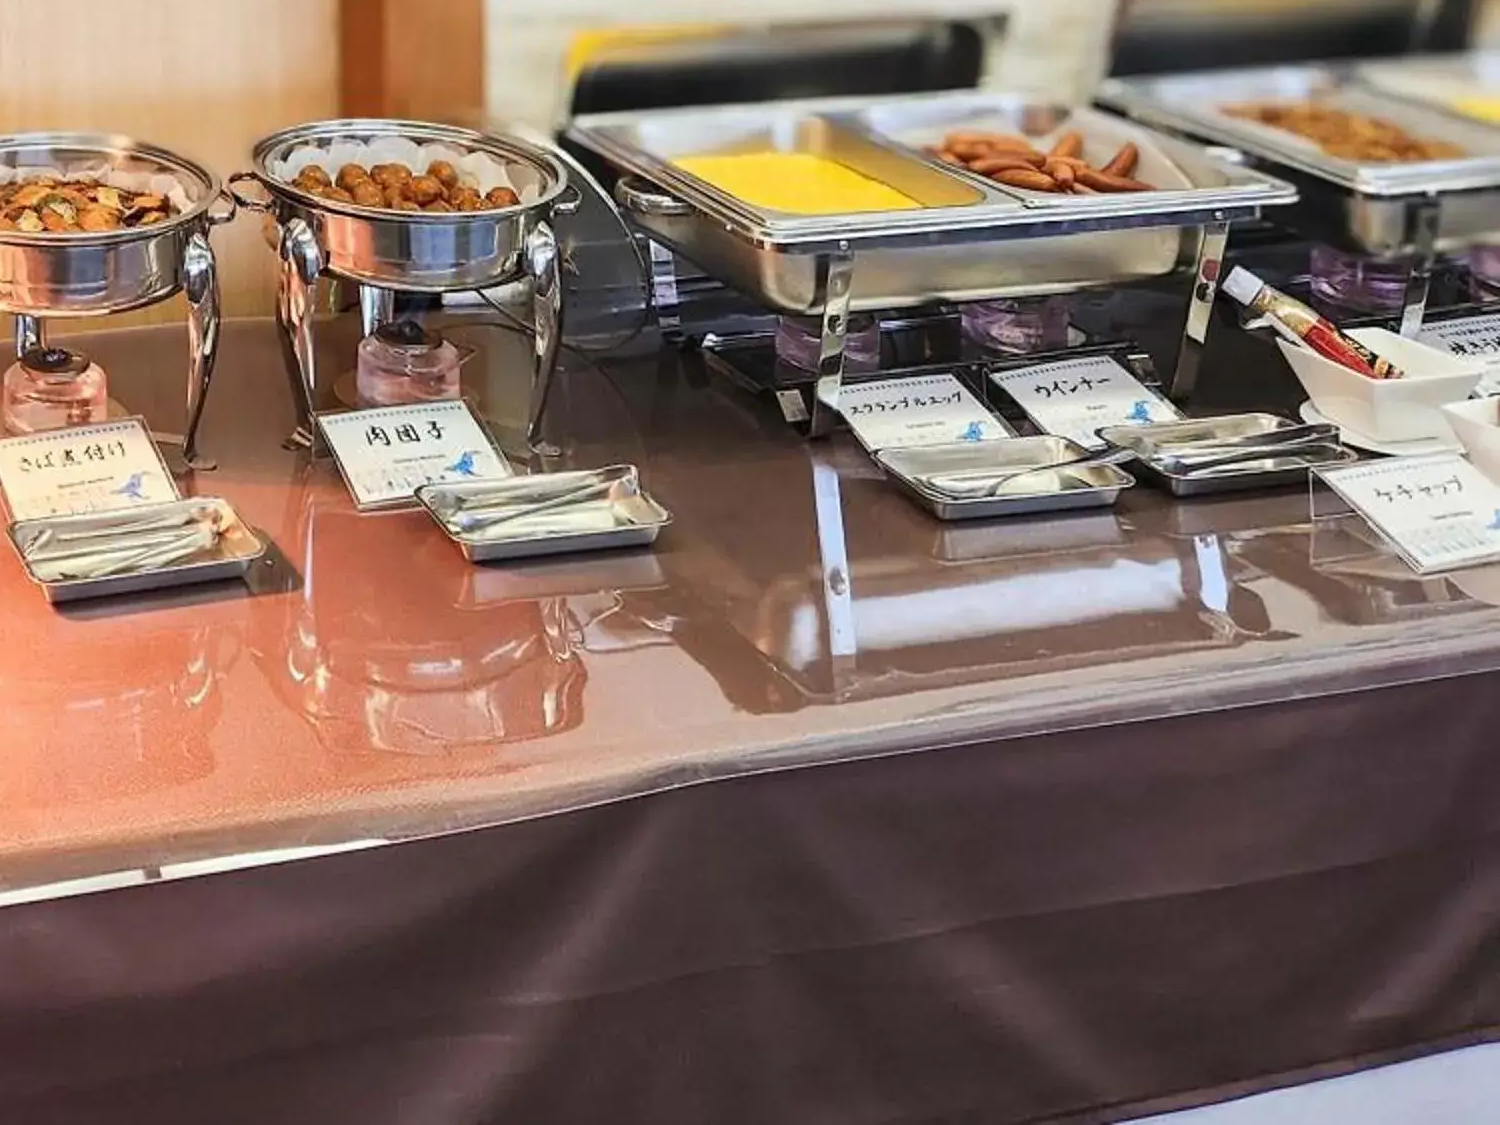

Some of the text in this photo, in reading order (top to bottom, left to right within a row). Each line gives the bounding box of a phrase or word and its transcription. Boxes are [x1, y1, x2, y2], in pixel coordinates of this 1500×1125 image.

[365, 420, 445, 446] 肉団子
[19, 440, 126, 473] さば煮付け
